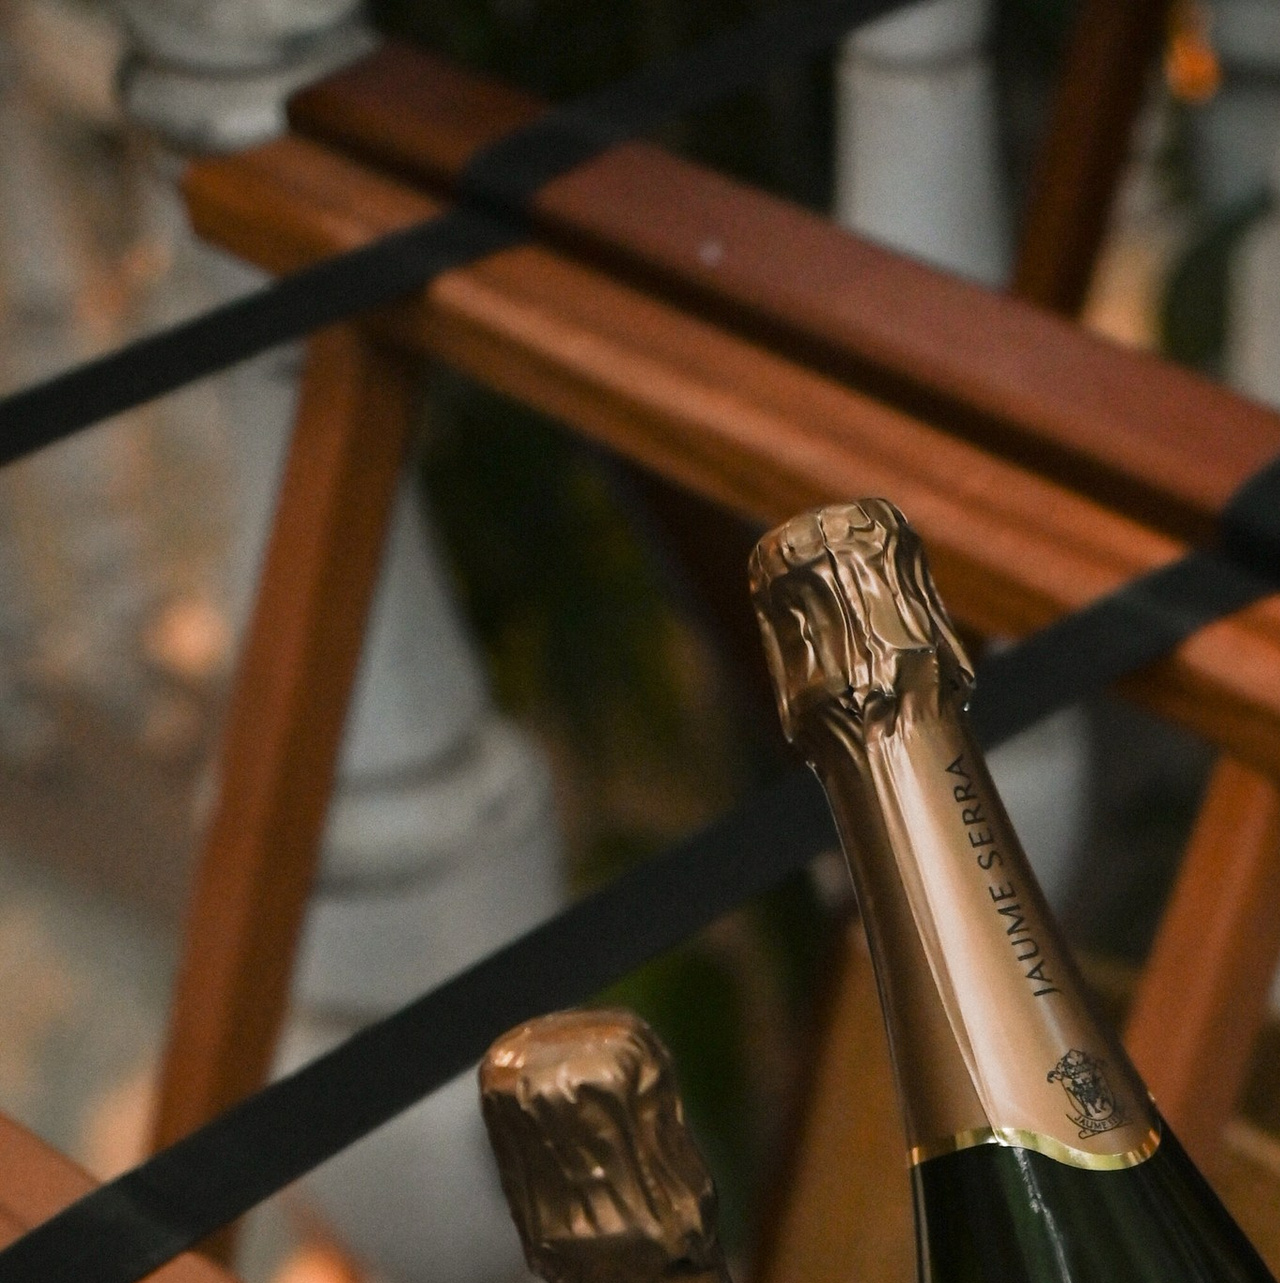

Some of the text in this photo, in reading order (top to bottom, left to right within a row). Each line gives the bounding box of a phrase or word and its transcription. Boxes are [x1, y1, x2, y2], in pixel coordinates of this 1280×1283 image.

[945, 753, 1062, 998] JAUME SERRA
[1074, 1115, 1108, 1130] JAUME
